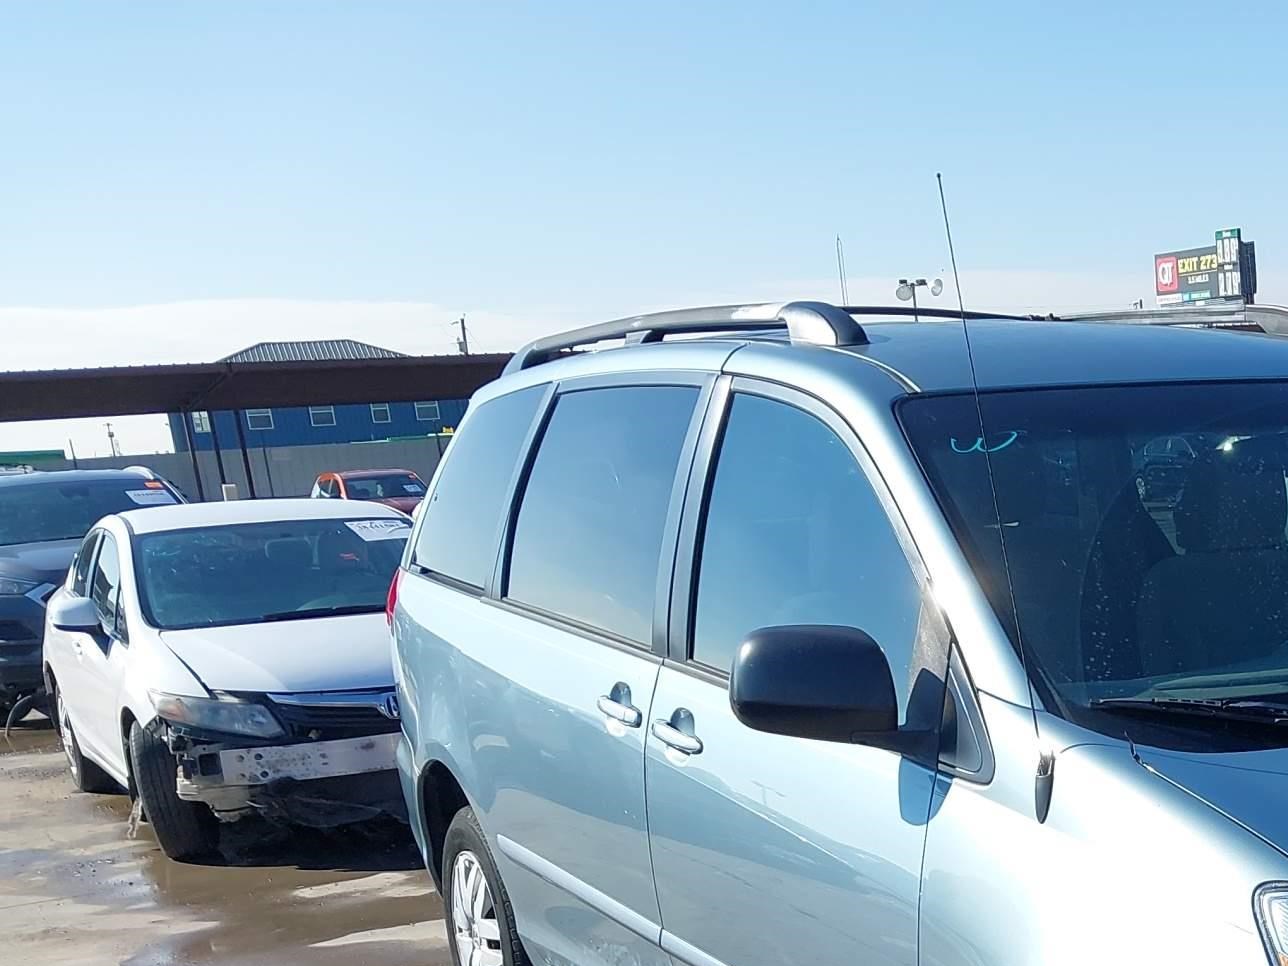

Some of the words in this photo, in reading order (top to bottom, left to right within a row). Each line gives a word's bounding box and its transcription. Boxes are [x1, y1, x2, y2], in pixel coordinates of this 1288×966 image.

[1158, 262, 1173, 287] QT
[1178, 257, 1198, 273] EXIT
[1199, 254, 1217, 270] 273
